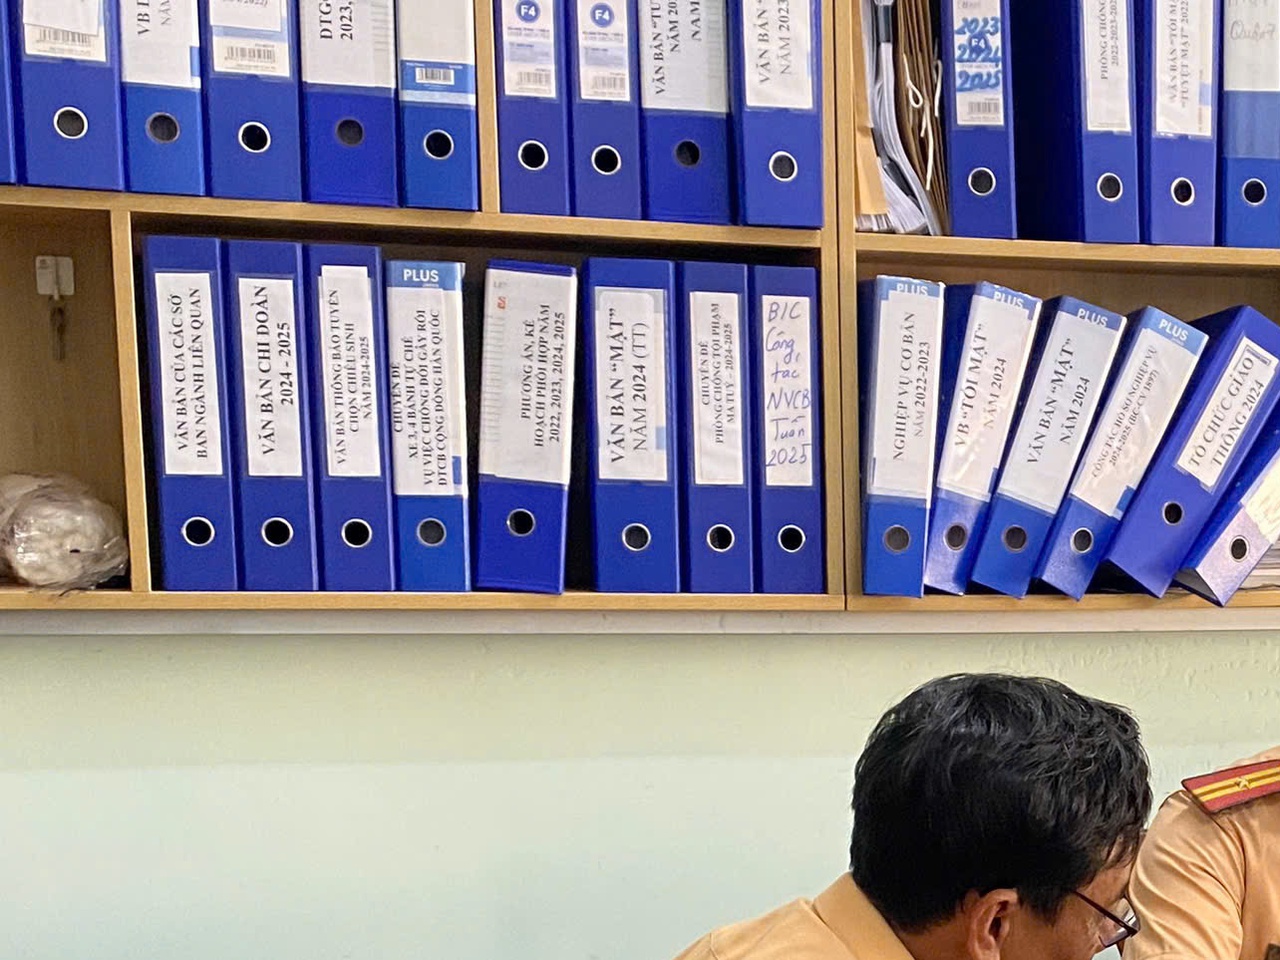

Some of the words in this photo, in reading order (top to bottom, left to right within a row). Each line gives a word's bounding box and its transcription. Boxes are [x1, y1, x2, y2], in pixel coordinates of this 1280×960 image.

[520, 5, 537, 17] F4
[594, 9, 610, 21] F4
[754, 9, 770, 43] BẢN
[955, 16, 1000, 36] 2023
[650, 32, 664, 61] BẢN
[667, 19, 681, 53] NĂM
[1109, 0, 1119, 66] 2022-2023-202
[756, 48, 771, 83] VĂN
[778, 37, 792, 75] NĂM
[652, 64, 666, 95] VĂN
[403, 268, 439, 283] PLUS
[897, 284, 928, 296] PLUS
[167, 294, 183, 314] SỞ
[189, 288, 204, 330] QUAN
[994, 292, 1024, 308] PLUS
[169, 318, 184, 348] CÁC
[523, 319, 535, 337] KẾ
[538, 304, 550, 334] NĂM
[553, 312, 565, 340] 2025
[711, 303, 722, 335] PHẠM
[903, 312, 916, 343] BẢN
[1077, 308, 1109, 328] PLUS
[1158, 319, 1189, 342] PLUS
[188, 334, 204, 368] LIÊN
[277, 323, 292, 356] 2025
[329, 335, 342, 360] BÁO
[344, 323, 355, 352] SINH
[415, 335, 428, 360] GÂY
[523, 341, 535, 362] ÁN,
[539, 336, 550, 364] HỢP
[631, 322, 650, 359] (TT)
[712, 339, 723, 359] TỘI
[724, 324, 734, 370] 2024-2025
[171, 353, 186, 382] CỦA
[257, 342, 272, 373] CHI
[359, 336, 371, 388] 2024-2025
[432, 348, 444, 374] HÀN
[552, 344, 564, 374] 2024,
[901, 347, 912, 372] CƠ
[279, 372, 294, 405] 2024
[331, 363, 344, 408] THÔNG
[632, 364, 647, 402] 2024
[698, 359, 711, 405] CHUYÊN
[712, 361, 723, 402] CHỐNG
[899, 376, 913, 397] VỤ
[915, 341, 931, 408] 2022-2023
[173, 387, 187, 415] BẢN
[191, 373, 206, 424] NGÀNH
[256, 378, 274, 413] BẢN
[361, 392, 373, 419] NĂM
[404, 385, 417, 419] BÁNH
[520, 364, 534, 420] PHƯƠNG
[550, 378, 563, 408] 2023,
[605, 377, 625, 417] BẢN
[983, 391, 996, 429] NĂM
[991, 358, 1007, 389] 2024
[334, 411, 346, 435] BẢN
[347, 397, 360, 432] CHỌN
[534, 401, 547, 448] HOẠCH
[713, 404, 725, 443] PHÒNG
[726, 405, 736, 423] MA
[914, 409, 926, 438] NĂM
[1060, 410, 1080, 445] NĂM
[1072, 376, 1091, 408] 2024
[1209, 410, 1246, 467] THÔNG
[1241, 378, 1264, 411] 2024
[175, 420, 189, 450] VĂN
[259, 420, 275, 455] VĂN
[549, 412, 562, 442] 2022,
[630, 407, 648, 451] NĂM
[893, 401, 910, 462] NGHIỆP
[954, 422, 969, 447] VB
[1027, 433, 1046, 464] VĂN
[1038, 399, 1059, 429] BẢN
[1186, 443, 1207, 468] TỔ
[1199, 395, 1232, 443] CHỨC
[196, 428, 208, 458] BAN
[335, 439, 347, 464] VĂN
[408, 443, 419, 459] XE
[421, 437, 434, 465] VIỆC
[607, 423, 626, 463] VĂN
[765, 443, 812, 467] 2025
[424, 469, 436, 486] VỤ
